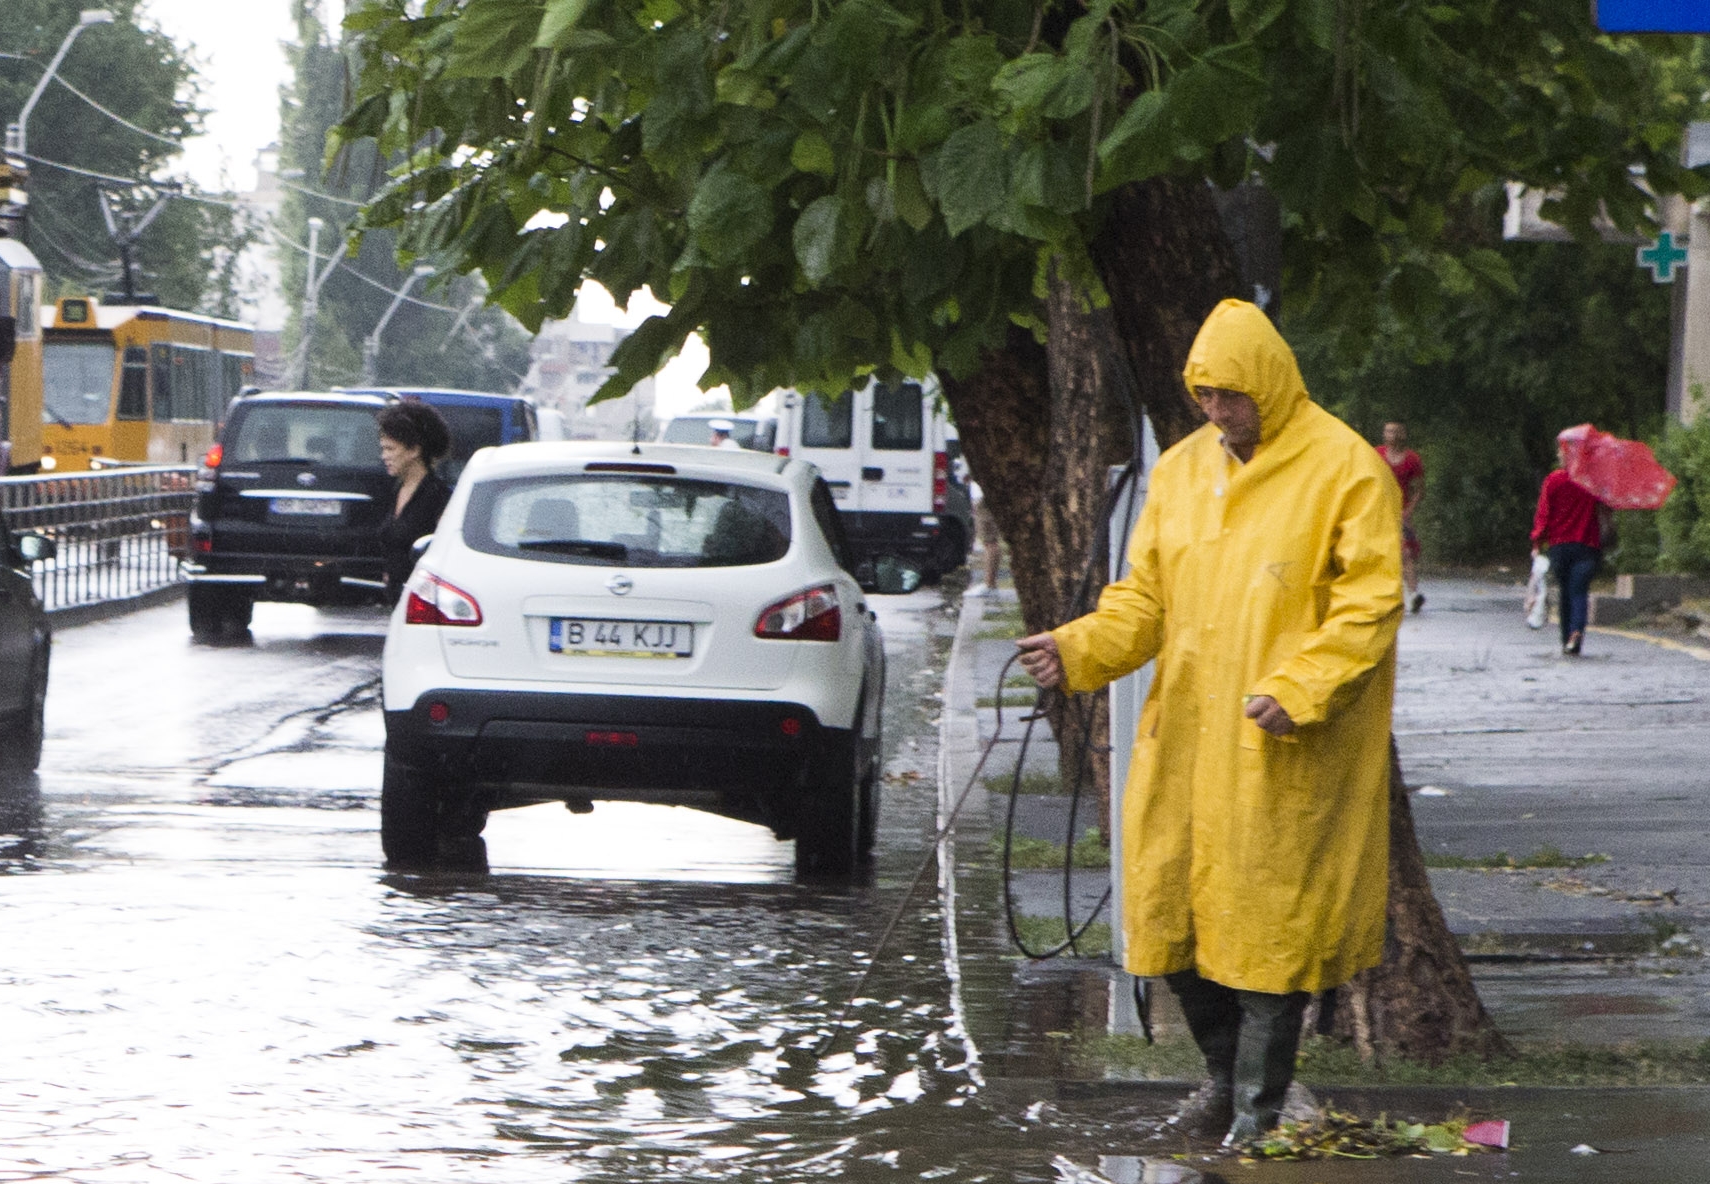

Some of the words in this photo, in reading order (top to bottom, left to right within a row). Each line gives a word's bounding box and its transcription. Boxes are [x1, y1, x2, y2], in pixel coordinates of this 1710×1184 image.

[568, 622, 585, 645] B
[594, 623, 621, 646] 44
[633, 624, 677, 648] KJJ
